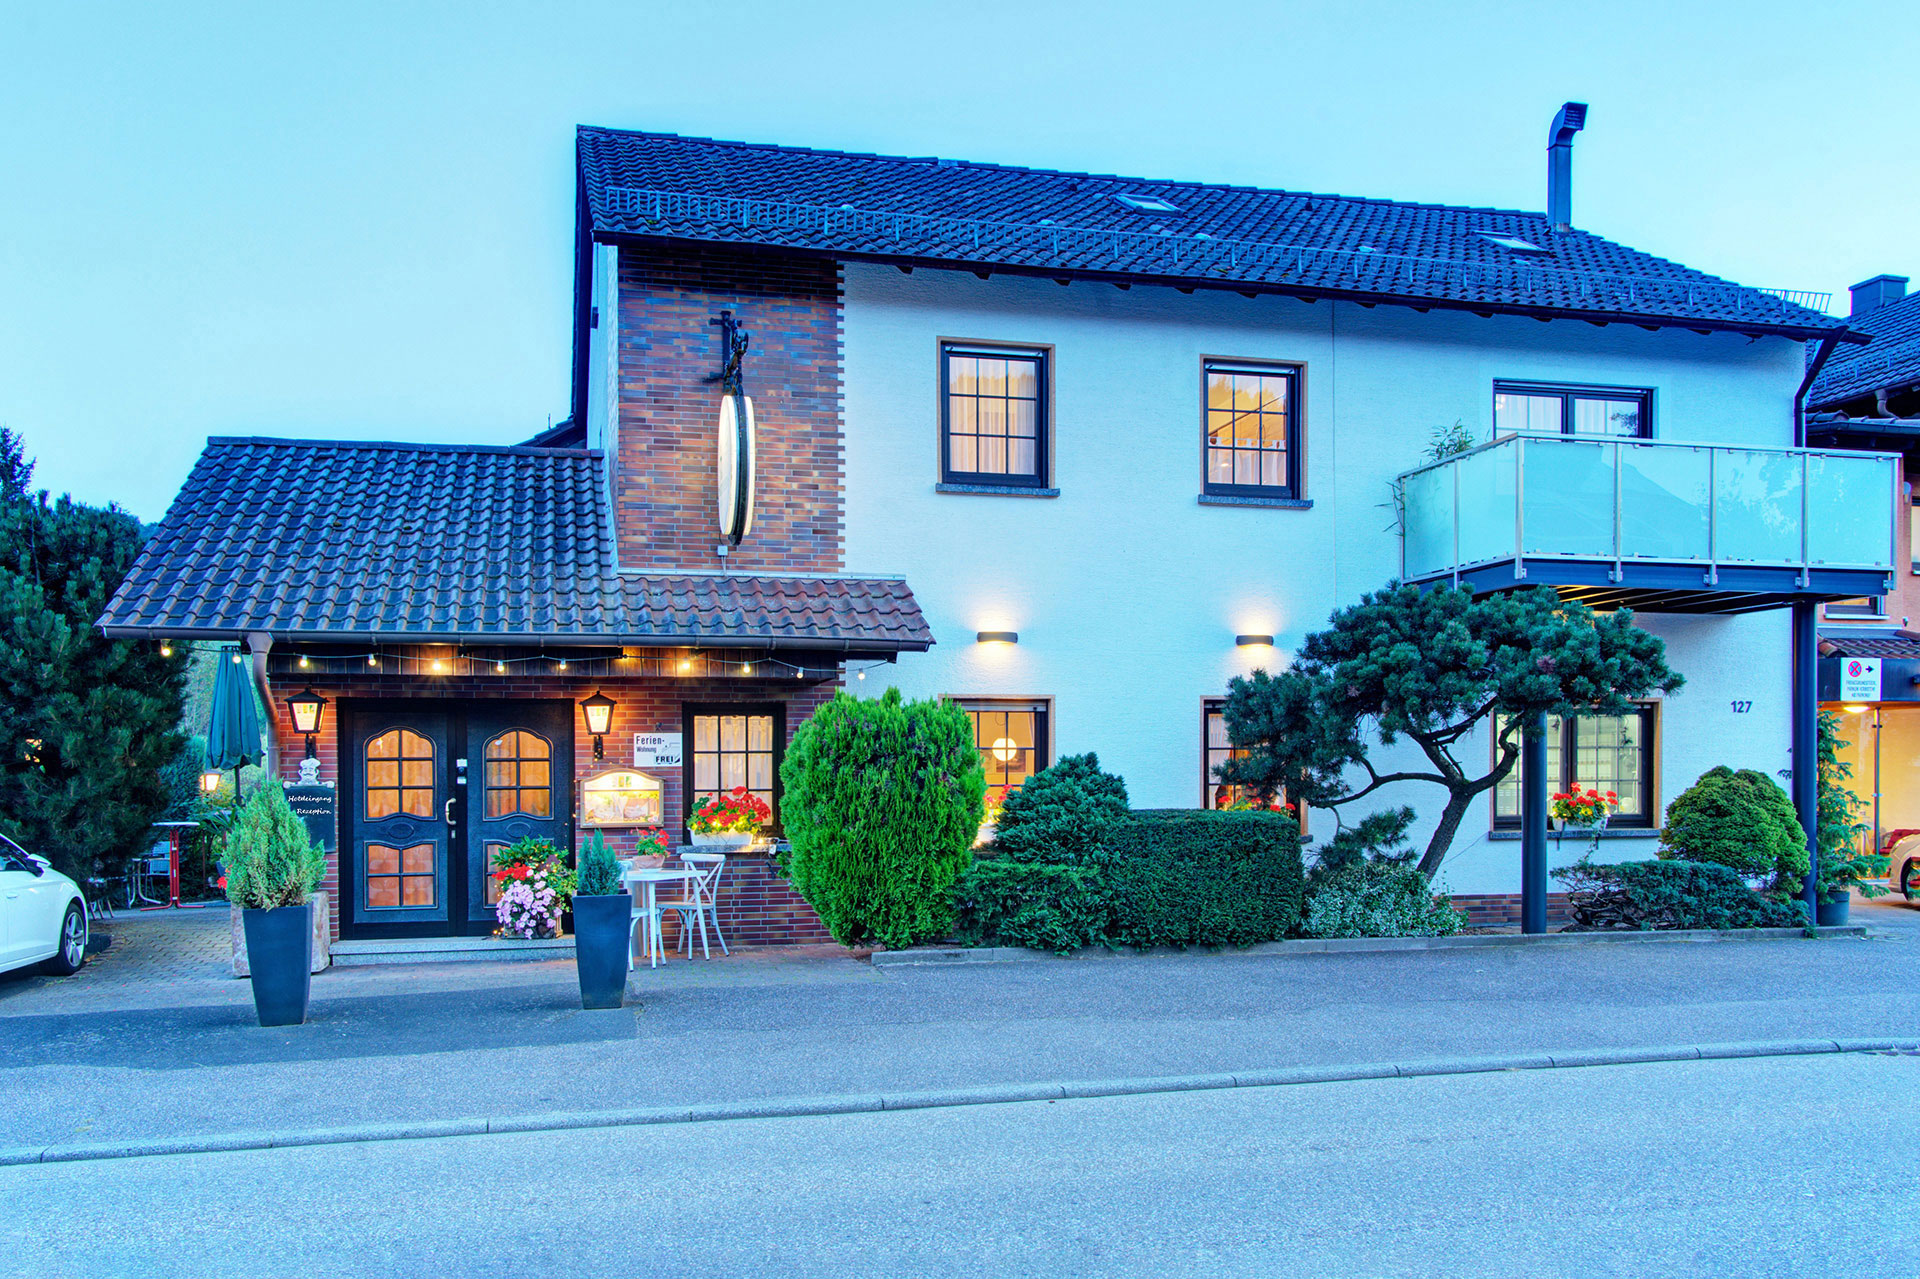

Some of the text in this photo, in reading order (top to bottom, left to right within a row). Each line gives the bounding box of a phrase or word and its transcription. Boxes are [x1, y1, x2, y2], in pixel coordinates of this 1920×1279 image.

[1730, 700, 1753, 713] 127
[636, 736, 665, 745] Ferien-
[296, 807, 332, 815] Rezeption
